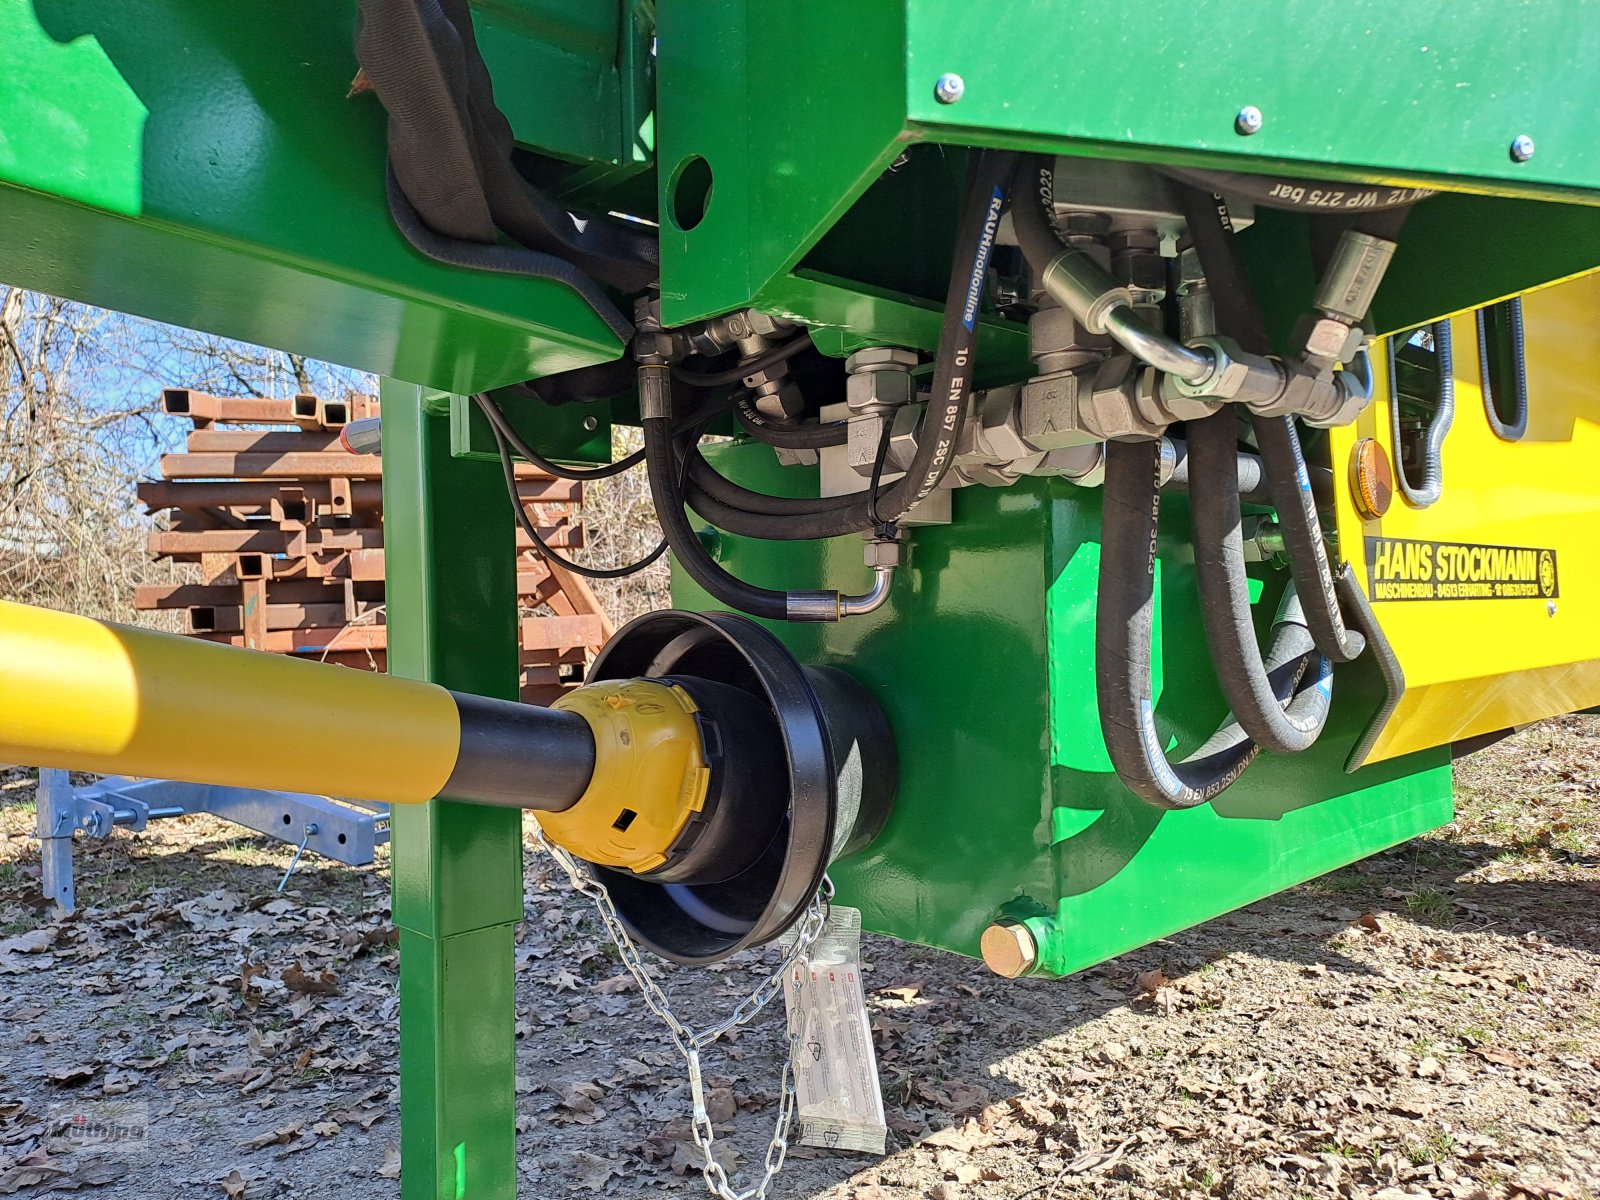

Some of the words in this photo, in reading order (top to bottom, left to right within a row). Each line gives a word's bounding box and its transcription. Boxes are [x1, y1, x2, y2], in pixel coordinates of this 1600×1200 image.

[1269, 183, 1307, 204] bar
[1307, 190, 1345, 206] 275
[1348, 191, 1378, 208] WP
[1389, 189, 1412, 204] 12
[1217, 205, 1232, 231] bar
[964, 197, 1003, 322] RAUHmotionline
[955, 347, 969, 367] 10
[949, 376, 964, 402] EN
[943, 404, 959, 431] 857
[933, 439, 950, 466] 2SC
[1151, 494, 1160, 523] bar
[1374, 541, 1433, 580] HANS
[1436, 545, 1537, 581] STOCKMANN
[1375, 582, 1434, 599] MASCHINENBAU
[1183, 786, 1193, 800] 15
[1193, 788, 1205, 800] EN
[1206, 781, 1220, 797] 853
[1221, 768, 1236, 789] 2SN
[1237, 755, 1249, 775] DN
[1249, 744, 1259, 759] 19
